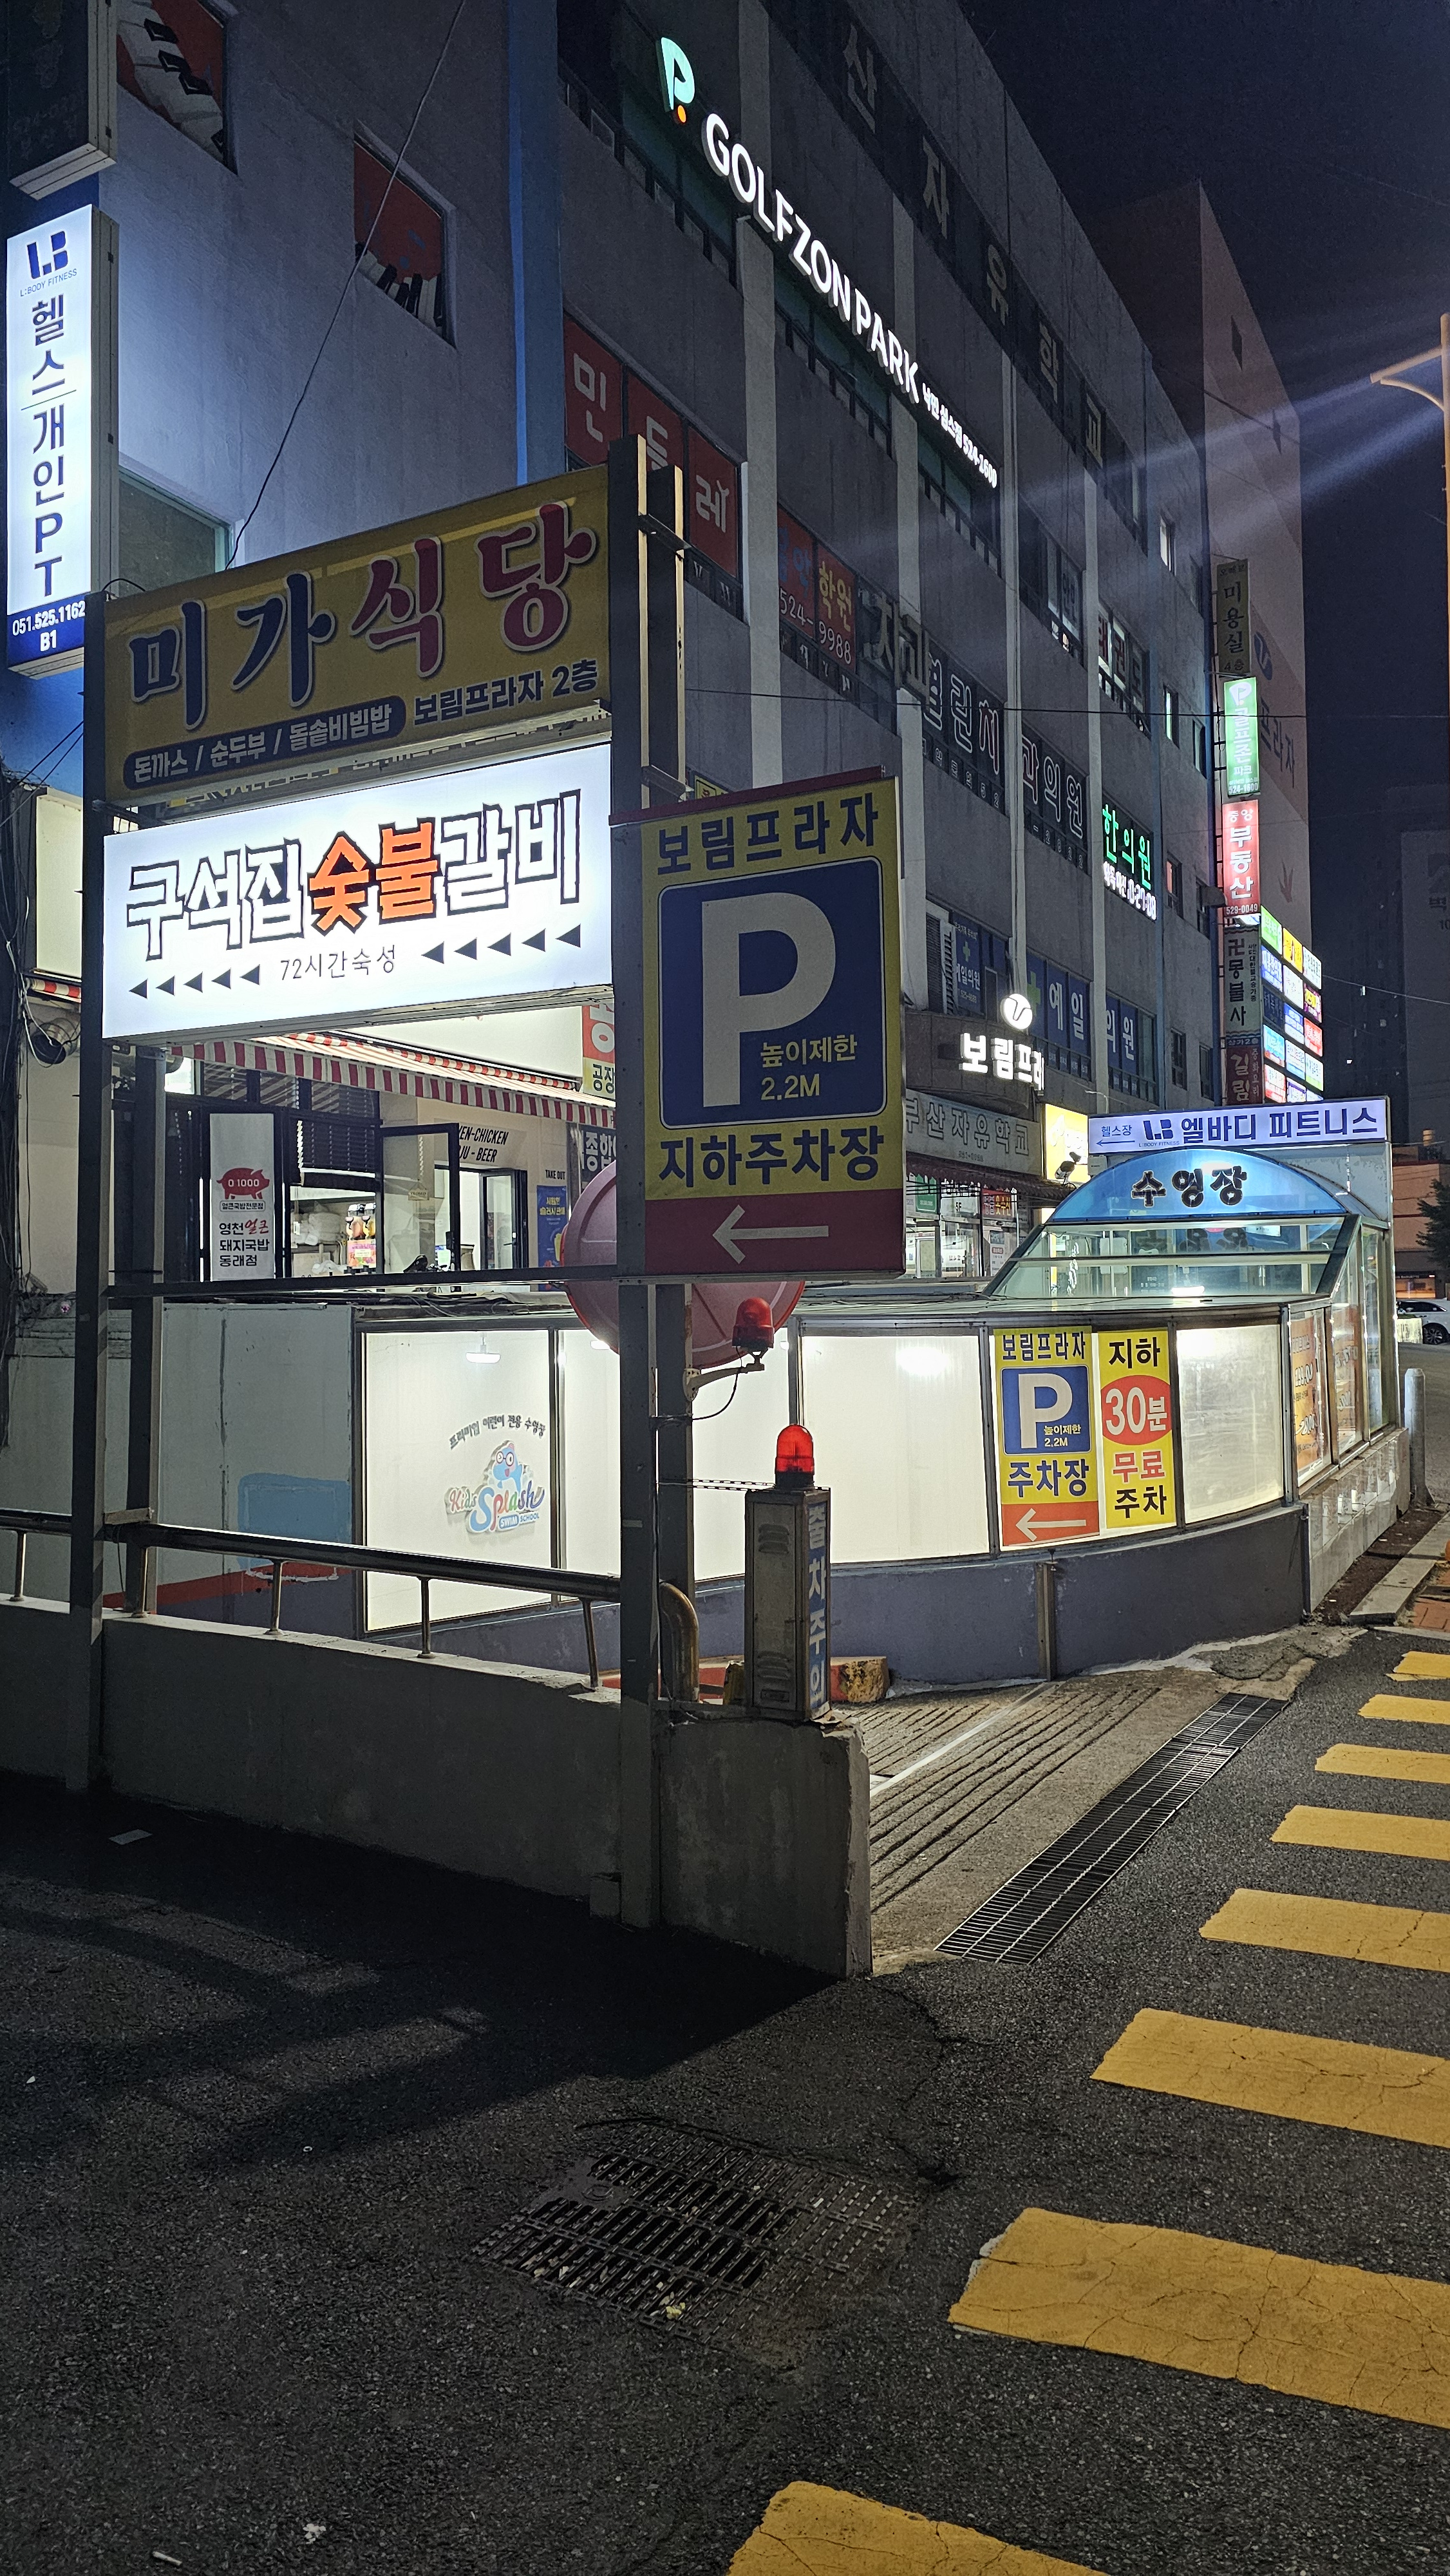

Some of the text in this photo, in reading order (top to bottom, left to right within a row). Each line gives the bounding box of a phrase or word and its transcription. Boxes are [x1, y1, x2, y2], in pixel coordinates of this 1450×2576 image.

[48, 269, 77, 287] FITNESS
[32, 293, 65, 395] 헬스
[963, 434, 997, 488] 524-1600
[818, 561, 852, 632] 학원
[12, 600, 86, 636] 051.525.1162
[128, 501, 598, 730] 미가식당
[779, 587, 851, 665] 524-9988
[1223, 581, 1244, 653] 미용실
[40, 630, 57, 652] B1
[413, 658, 599, 726] 보림프라자 2층
[133, 704, 392, 783] 돈까스 순두부 돌솥비빔밥
[1229, 783, 1259, 794] 524-1600
[1229, 809, 1254, 822] 중앙
[657, 793, 879, 875] 보림프라자
[1102, 804, 1151, 890] 한의원
[1230, 826, 1254, 900] 부동산
[1226, 904, 1258, 914] 529-0049
[280, 944, 397, 981] 72시간숙성
[702, 892, 836, 1108] P
[760, 1034, 856, 1068] 높이제한
[760, 1074, 821, 1102] 2.2M
[1230, 1053, 1250, 1101] 길림
[1101, 1124, 1133, 1137] 헬스장
[1182, 1107, 1378, 1144] 엘바디 피트니스
[476, 1147, 498, 1162] BEER
[659, 1126, 884, 1188] 지하주차장
[238, 1179, 259, 1187] 1000
[545, 1170, 565, 1180] TAKE OUT
[1132, 1166, 1247, 1208] 수영장
[956, 1201, 963, 1211] 5F
[220, 1218, 269, 1235] 영천 얼큰
[220, 1238, 270, 1252] 돼지국밥
[220, 1255, 258, 1267] 동래점
[1003, 1331, 1086, 1361] 보림프라자
[1109, 1337, 1160, 1368] 지하
[1018, 1373, 1073, 1448] P
[1106, 1387, 1167, 1435] 30분
[449, 1421, 480, 1450] 프리미엄
[483, 1414, 505, 1429] 어린이
[508, 1415, 523, 1428] 전용
[1044, 1424, 1081, 1436] 높이제한
[1044, 1437, 1068, 1448] 2.2M
[1008, 1459, 1089, 1497] 주차장
[1113, 1450, 1165, 1483] 무료
[450, 1480, 545, 1531] Kids Splash
[520, 1513, 540, 1522] SCHOOL
[1115, 1484, 1167, 1519] 주차
